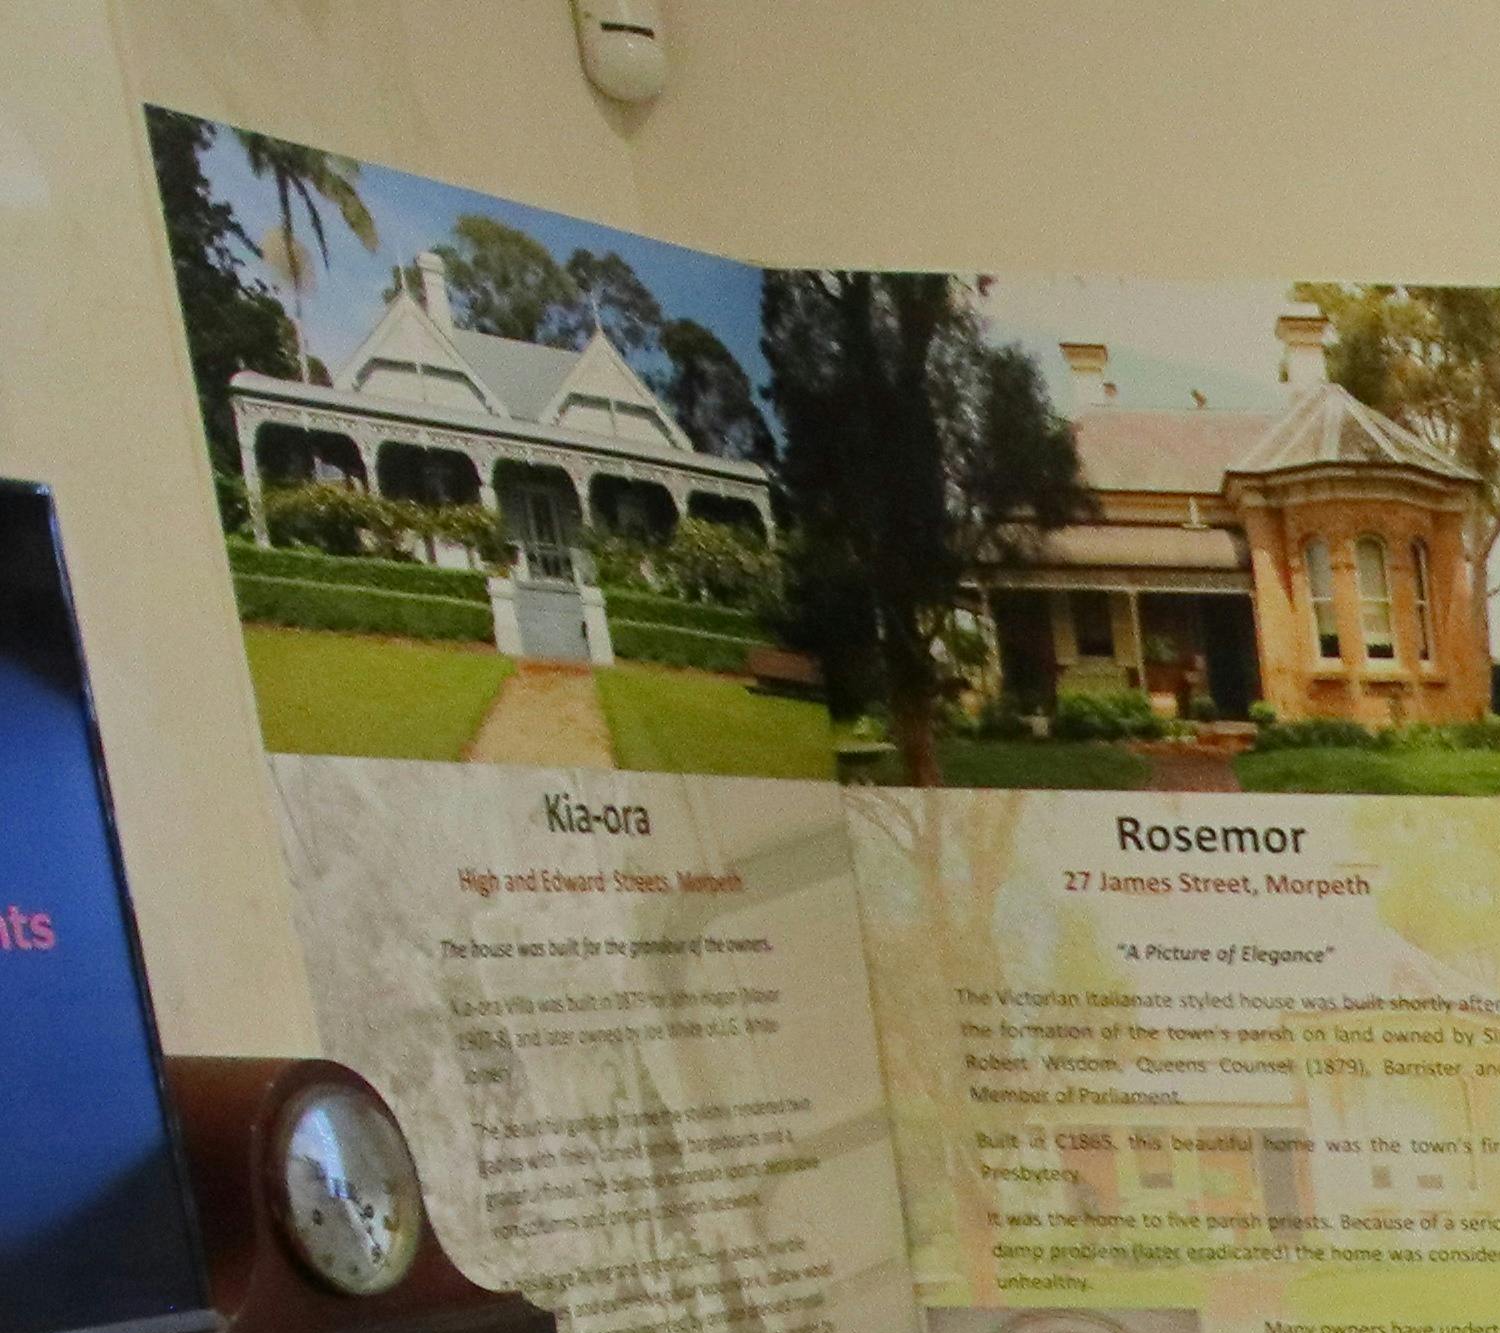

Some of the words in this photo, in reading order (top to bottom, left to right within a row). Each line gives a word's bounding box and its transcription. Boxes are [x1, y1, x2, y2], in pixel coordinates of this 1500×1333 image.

[543, 792, 652, 836] Kia-ora
[1116, 814, 1307, 854] Rosemor
[1063, 870, 1091, 891] 27
[1100, 872, 1172, 893] James
[1178, 873, 1258, 896] Street,
[1265, 874, 1370, 898] Morpeth
